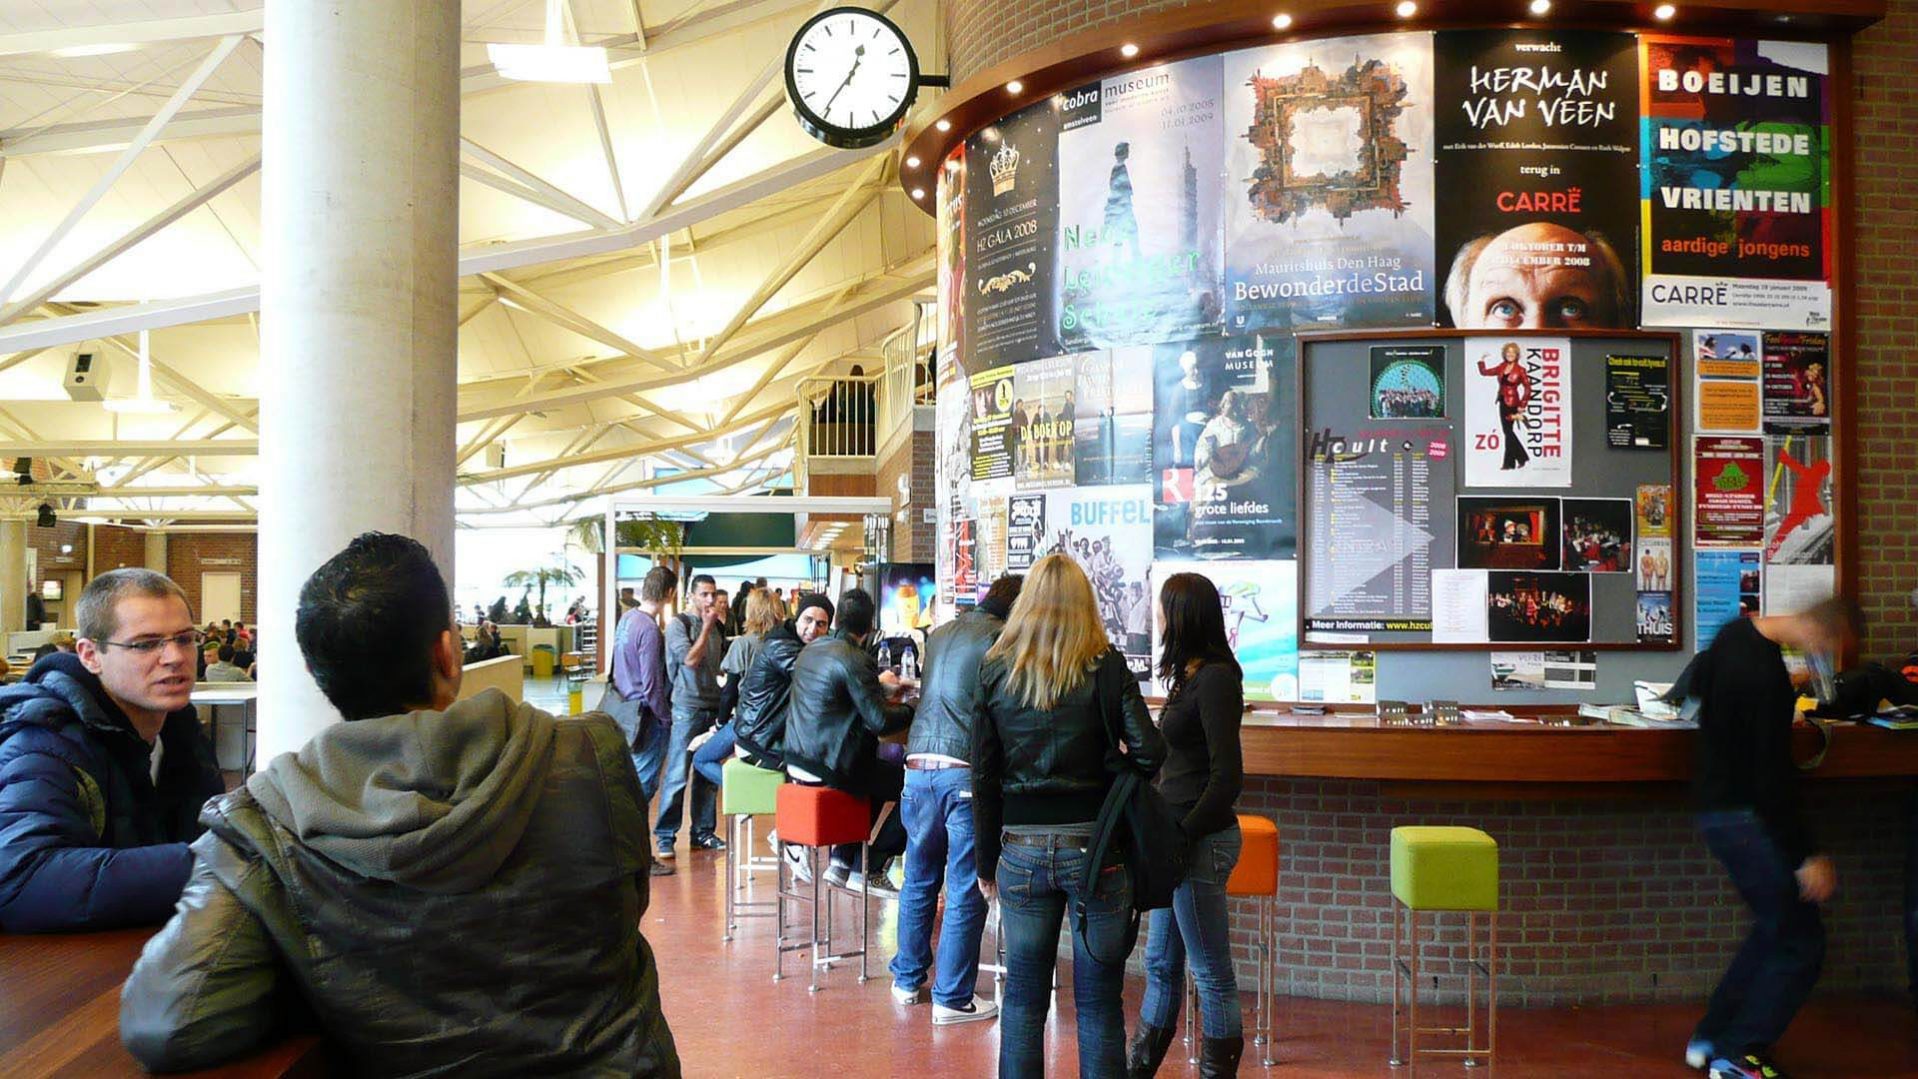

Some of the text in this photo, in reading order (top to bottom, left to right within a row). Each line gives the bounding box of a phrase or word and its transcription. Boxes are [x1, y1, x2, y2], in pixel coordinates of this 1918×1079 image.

[1515, 42, 1562, 52] verwacht
[1470, 66, 1608, 98] HERMAN
[1658, 69, 1808, 98] BOEIJEN
[1062, 89, 1098, 111] cobra
[1104, 73, 1169, 98] museum
[1063, 115, 1098, 130] amstelveen
[1462, 97, 1616, 129] VAN VEEN
[1659, 127, 1810, 155] HOFSTEDE
[1520, 165, 1561, 178] terug in
[1661, 187, 1811, 214] VRIENTEN
[976, 219, 1038, 253] HZ GALA 2008
[1567, 243, 1587, 253] T/M
[1662, 237, 1810, 259] aardige jongens
[1255, 255, 1401, 276] Mauritshuis Den Haag
[1564, 257, 1591, 266] 2008
[1234, 270, 1425, 301] BewonderdeStad
[1225, 348, 1274, 359] VAN GOGH
[1224, 360, 1274, 370] MUSEM
[1526, 348, 1543, 458] KAANDORP
[1542, 348, 1561, 458] BRIGITTE
[1059, 420, 1073, 437] OP
[1332, 438, 1389, 454] cult
[1195, 501, 1269, 518] grote liefdes
[1312, 621, 1335, 630] Meer
[1336, 620, 1385, 630] Informatie:
[1637, 622, 1673, 635] THUIS
